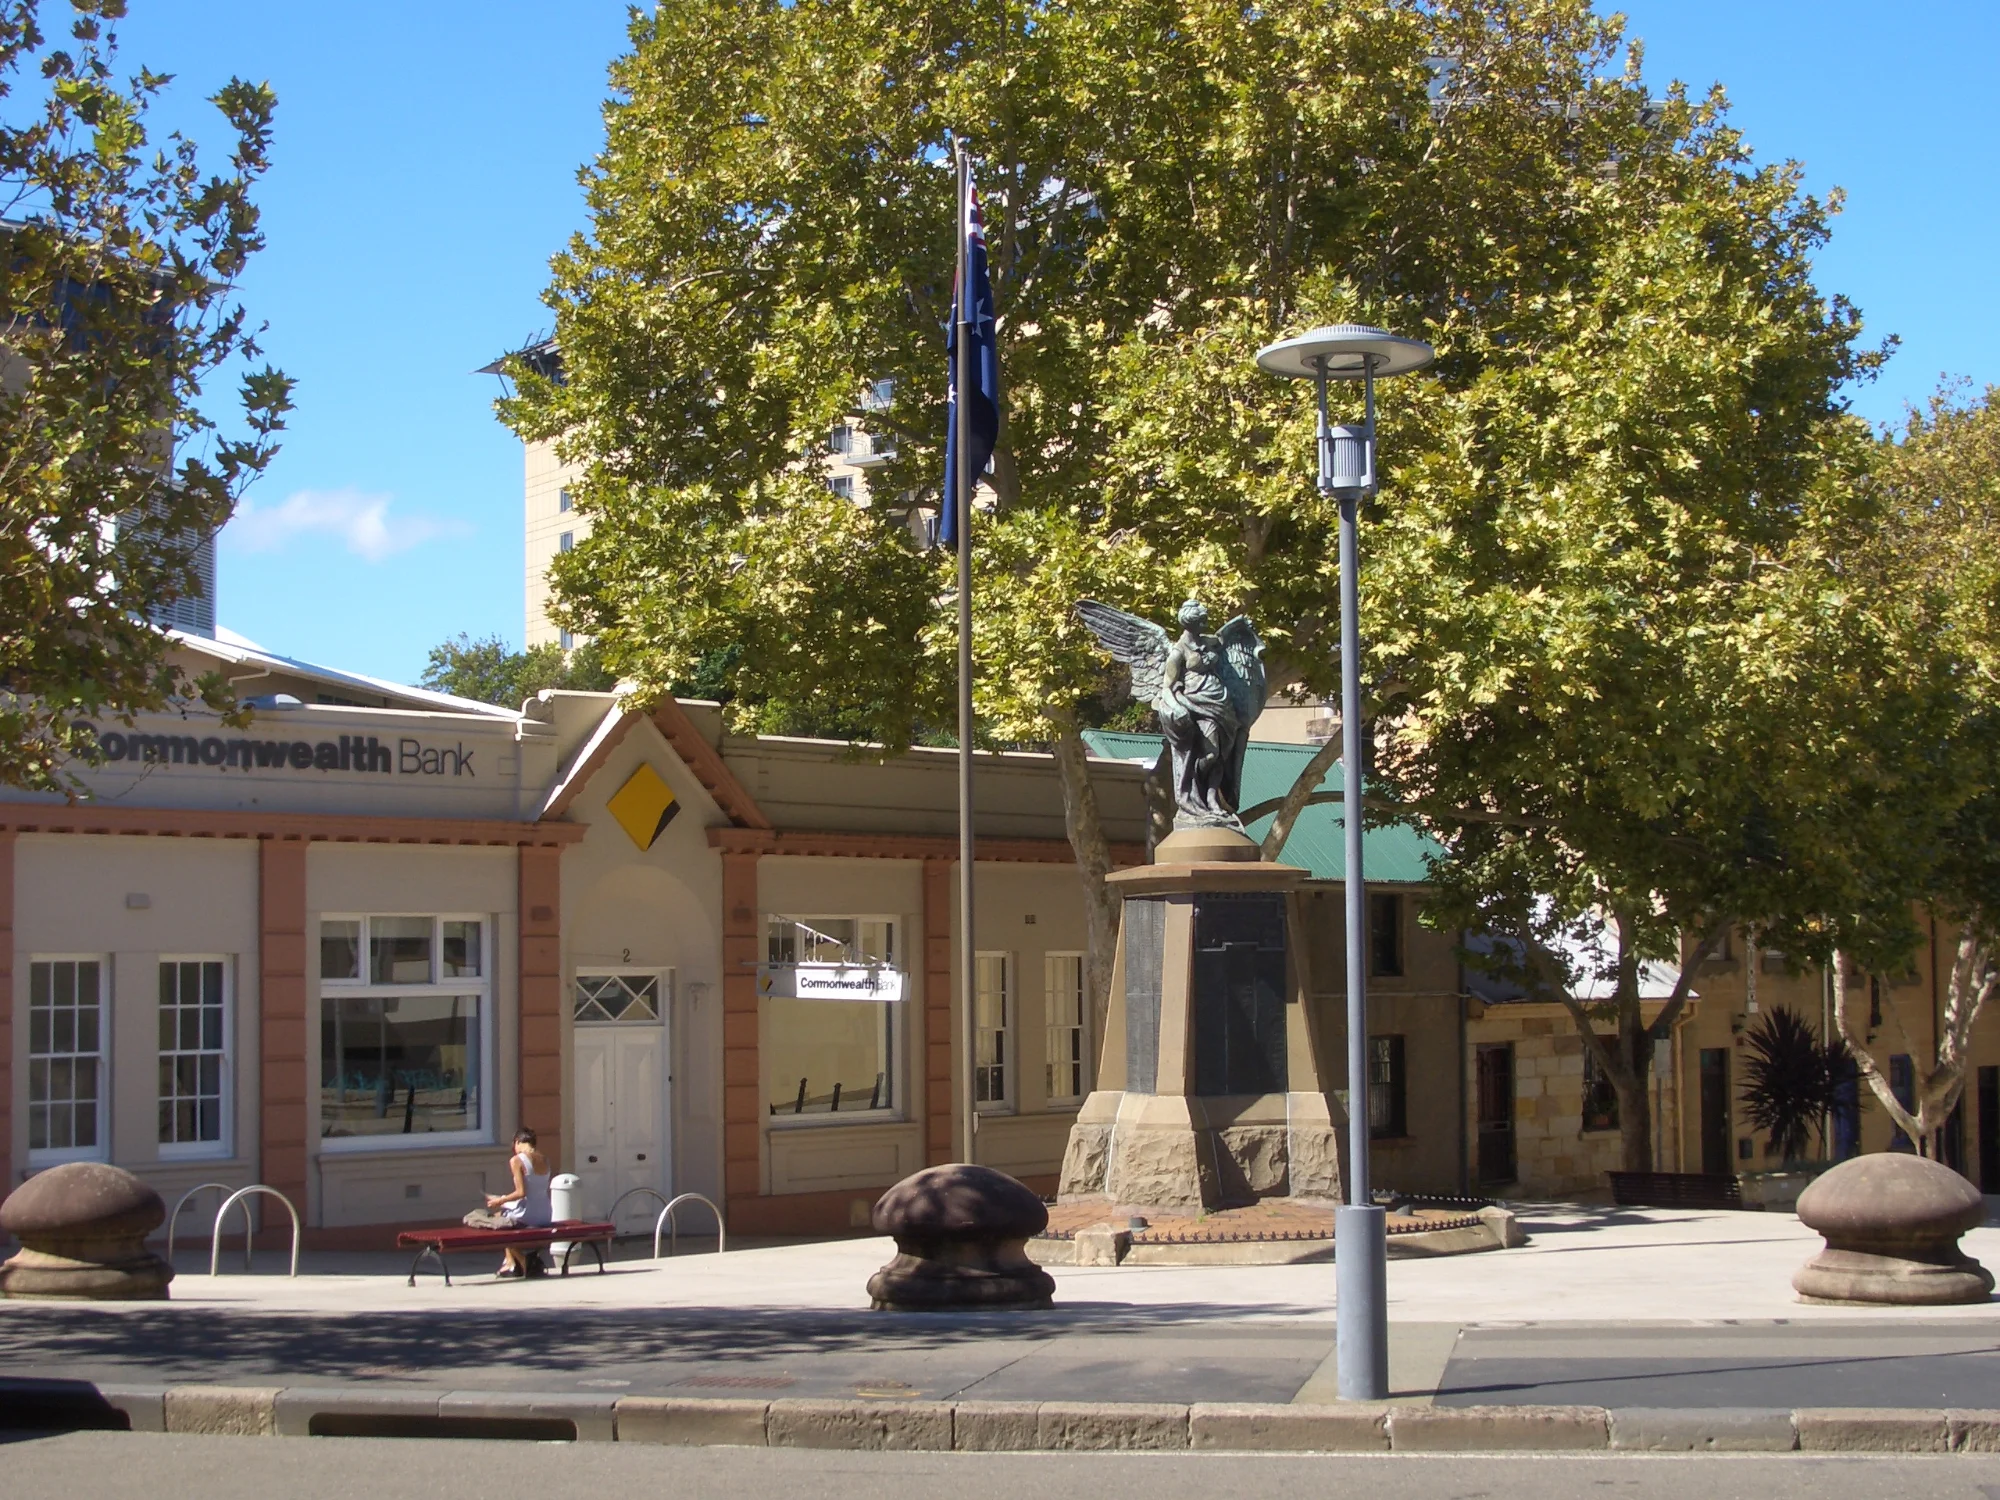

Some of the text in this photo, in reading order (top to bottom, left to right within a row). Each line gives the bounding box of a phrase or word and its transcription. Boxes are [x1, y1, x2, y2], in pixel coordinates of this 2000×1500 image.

[399, 738, 475, 777] Bank
[623, 948, 631, 963] 2
[800, 977, 896, 991] Commonwealth Bank
